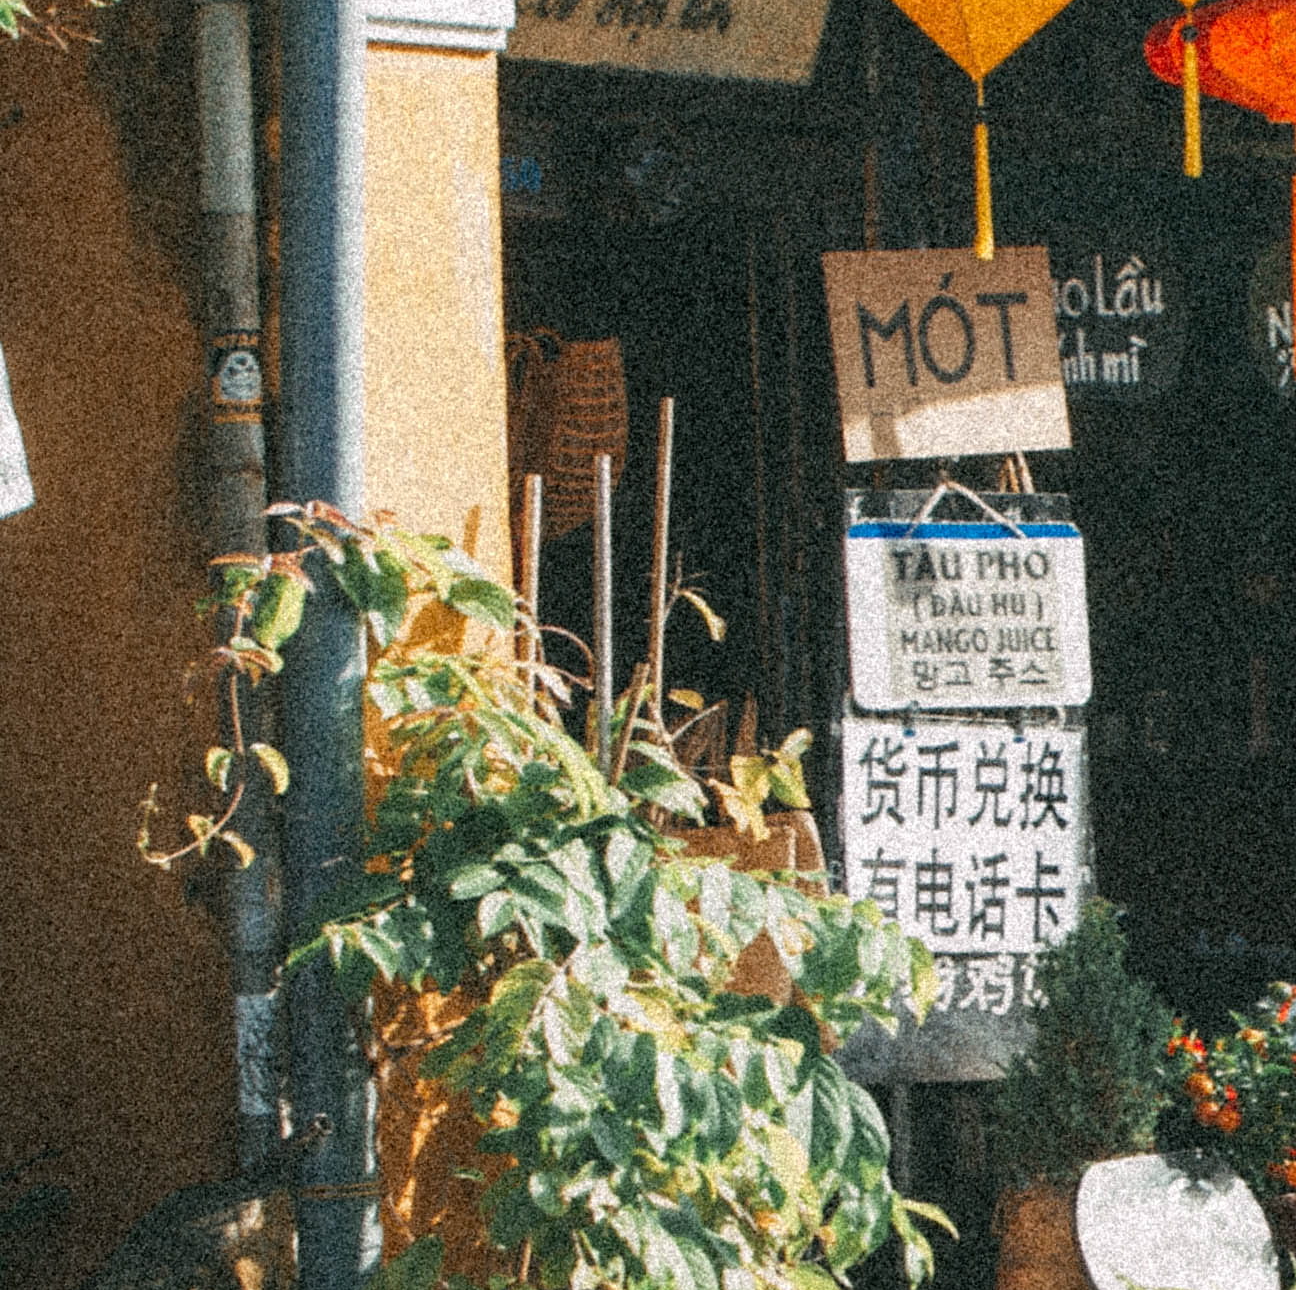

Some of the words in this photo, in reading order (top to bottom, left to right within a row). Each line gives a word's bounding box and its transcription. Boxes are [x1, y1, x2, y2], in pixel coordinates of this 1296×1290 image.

[857, 271, 1028, 390] MÓT
[899, 626, 990, 655] MANGO
[996, 625, 1057, 653] JUICE
[859, 735, 1070, 831] 货币兑换
[860, 846, 1068, 944] 有电话卡
